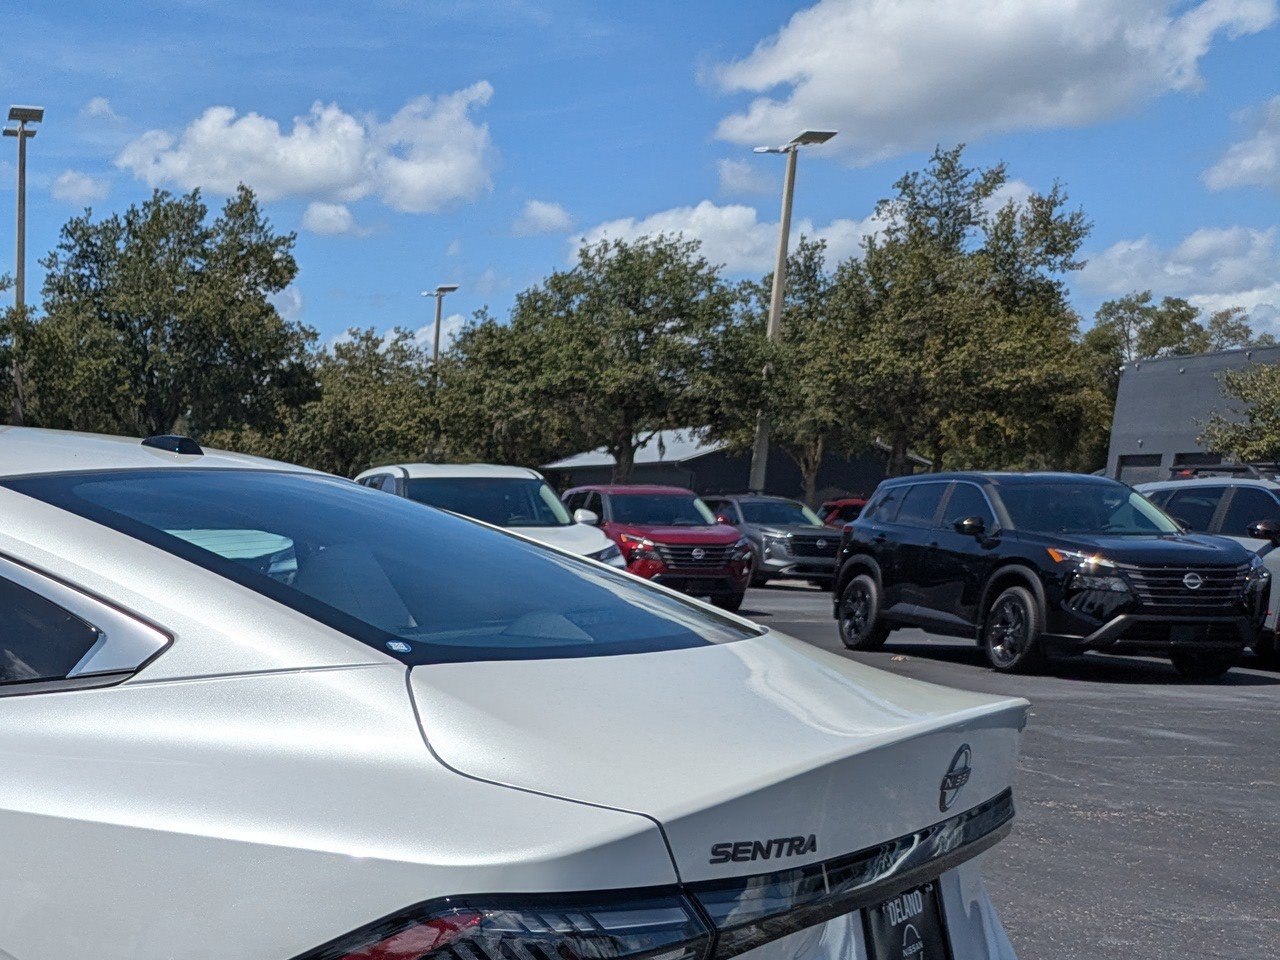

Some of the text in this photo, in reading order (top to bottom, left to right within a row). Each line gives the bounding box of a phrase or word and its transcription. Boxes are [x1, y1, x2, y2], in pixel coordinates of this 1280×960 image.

[709, 834, 817, 864] SENTRA
[888, 889, 924, 927] DELAND
[902, 941, 924, 957] NISSAN
